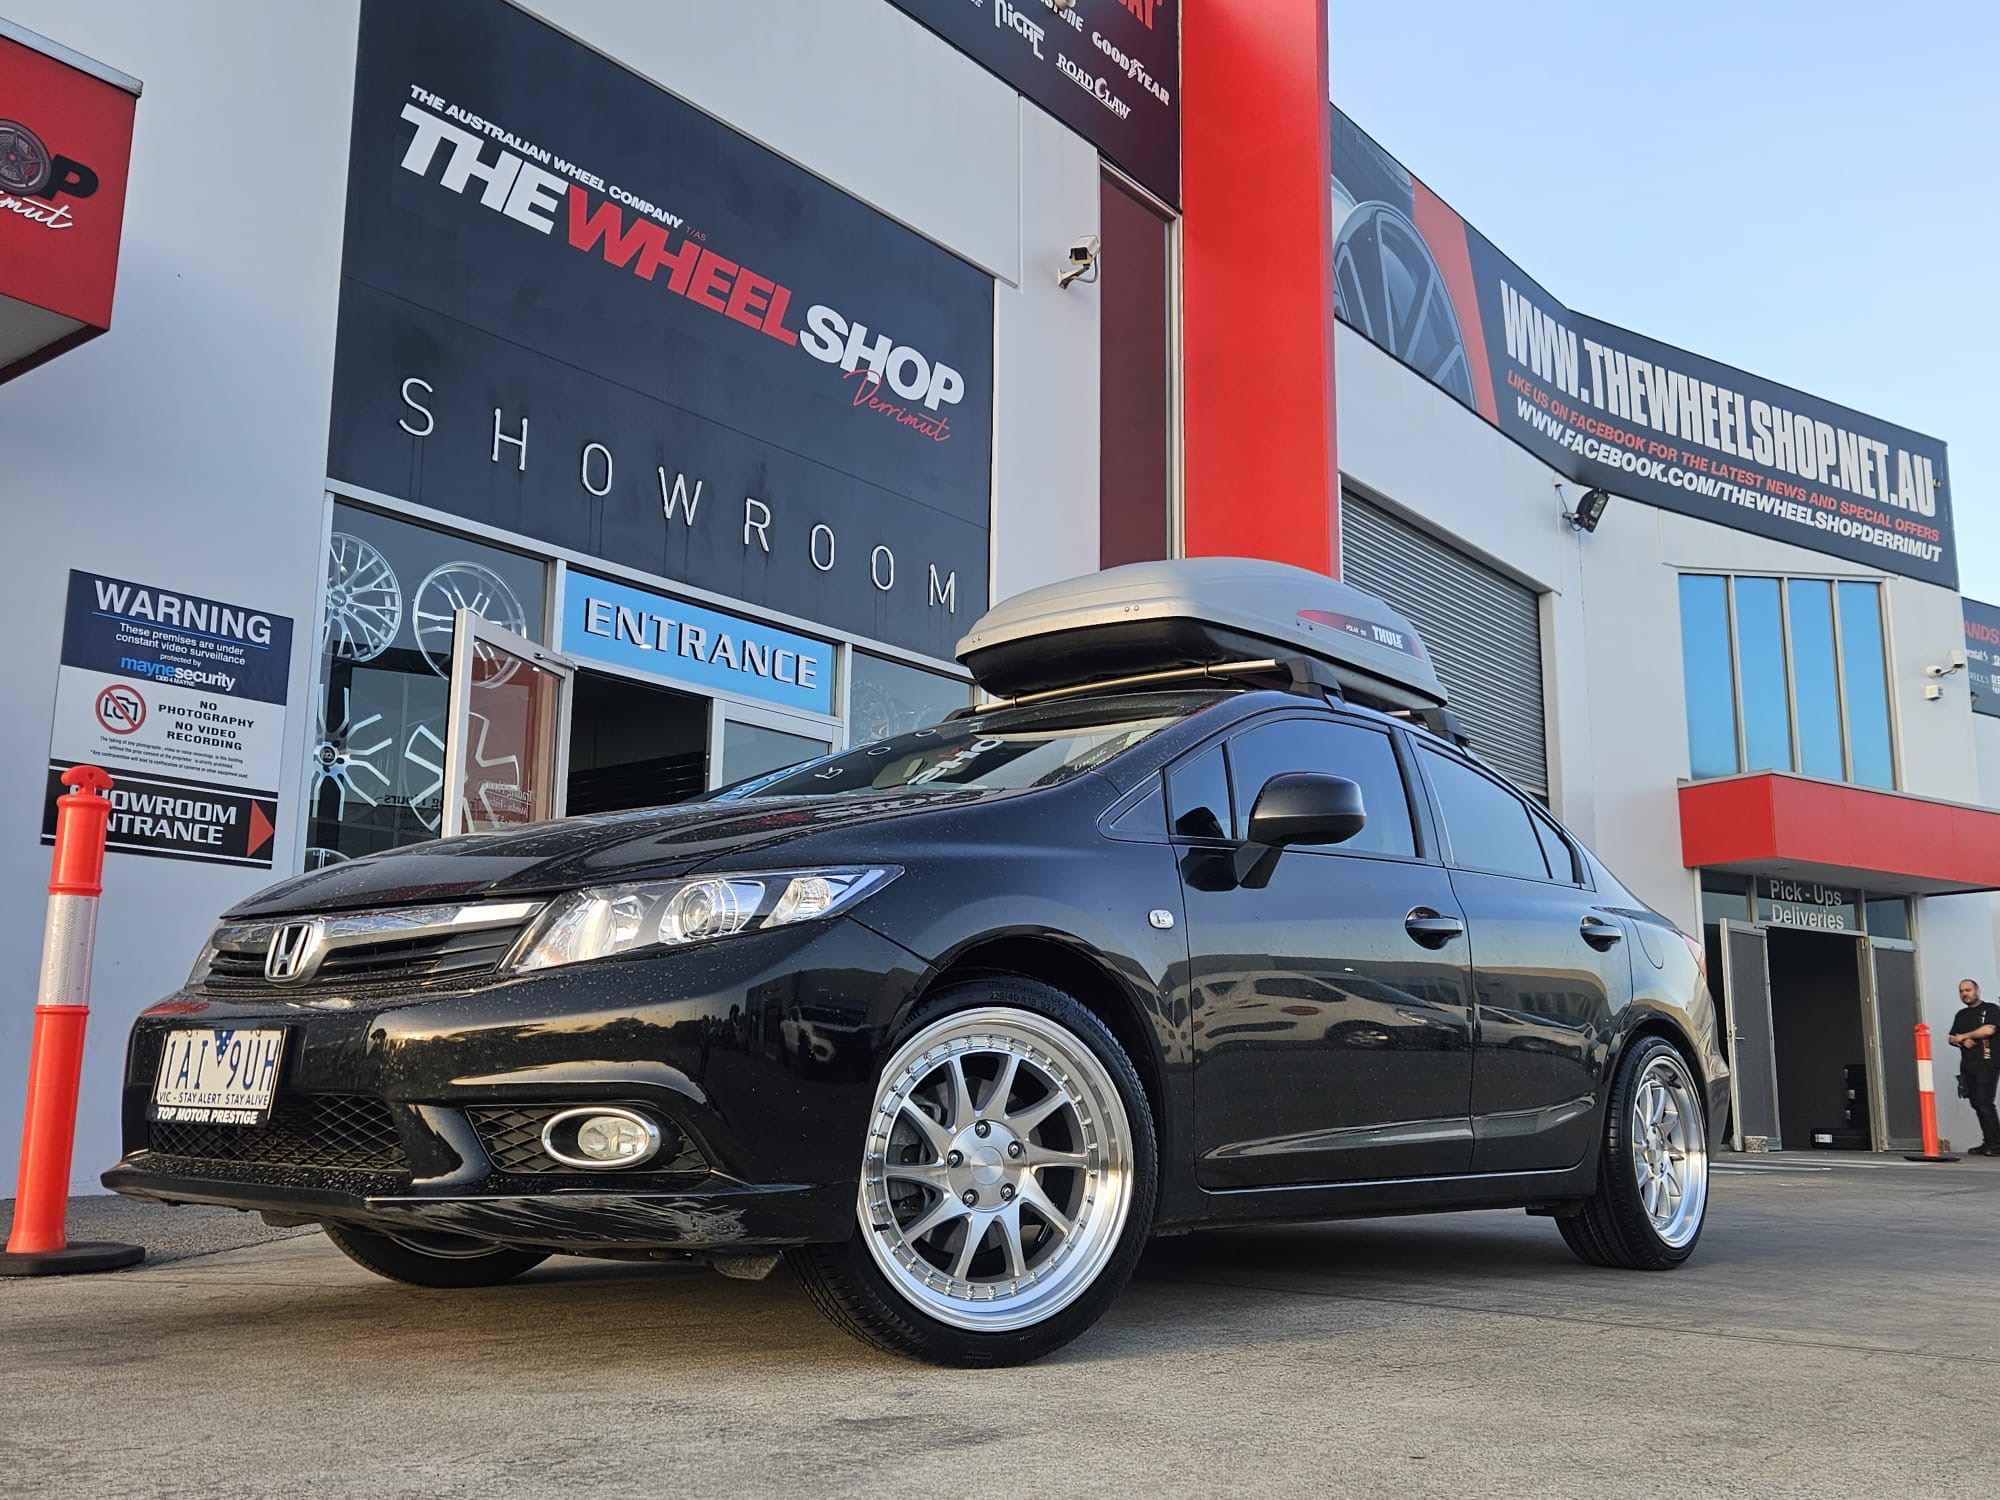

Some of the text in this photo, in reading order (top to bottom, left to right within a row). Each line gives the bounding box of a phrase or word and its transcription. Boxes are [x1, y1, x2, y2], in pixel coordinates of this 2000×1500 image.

[410, 84, 446, 111] THE
[445, 104, 551, 165] AUSTRALIAN
[553, 156, 606, 193] WHEEL
[608, 185, 684, 229] COMPANY
[1507, 368, 1940, 542] LIKE US ON FACEBOOK FOR THE LATEST NEWS AND SPECIAL OFFERS
[1516, 396, 1943, 563] WWW.FACEBOOK.COM/THEWHEELSHOPDERRIMUT
[94, 580, 272, 645] WARNING
[115, 633, 246, 666] constant video surveillance
[119, 622, 244, 656] These premises are under
[585, 597, 818, 690] ENTRANCE
[1371, 625, 1403, 649] THULE
[160, 653, 202, 668] protected by
[158, 703, 255, 729] PHOTOGRAPHY
[199, 700, 218, 711] NO
[167, 731, 242, 751] RECORDING
[175, 721, 236, 739] NO VIDEO
[106, 813, 224, 845] NTRANCE
[1770, 880, 1803, 902] Pick
[1813, 884, 1842, 909] Ups
[1772, 904, 1844, 930] Deliveries
[159, 1092, 171, 1103] VIC
[178, 1092, 198, 1104] STAY
[199, 1093, 222, 1105] ALERT
[225, 1094, 245, 1105] STAY
[245, 1094, 269, 1106] ALIVE
[157, 1107, 259, 1124] TOP MOTOR PRESTIGE
